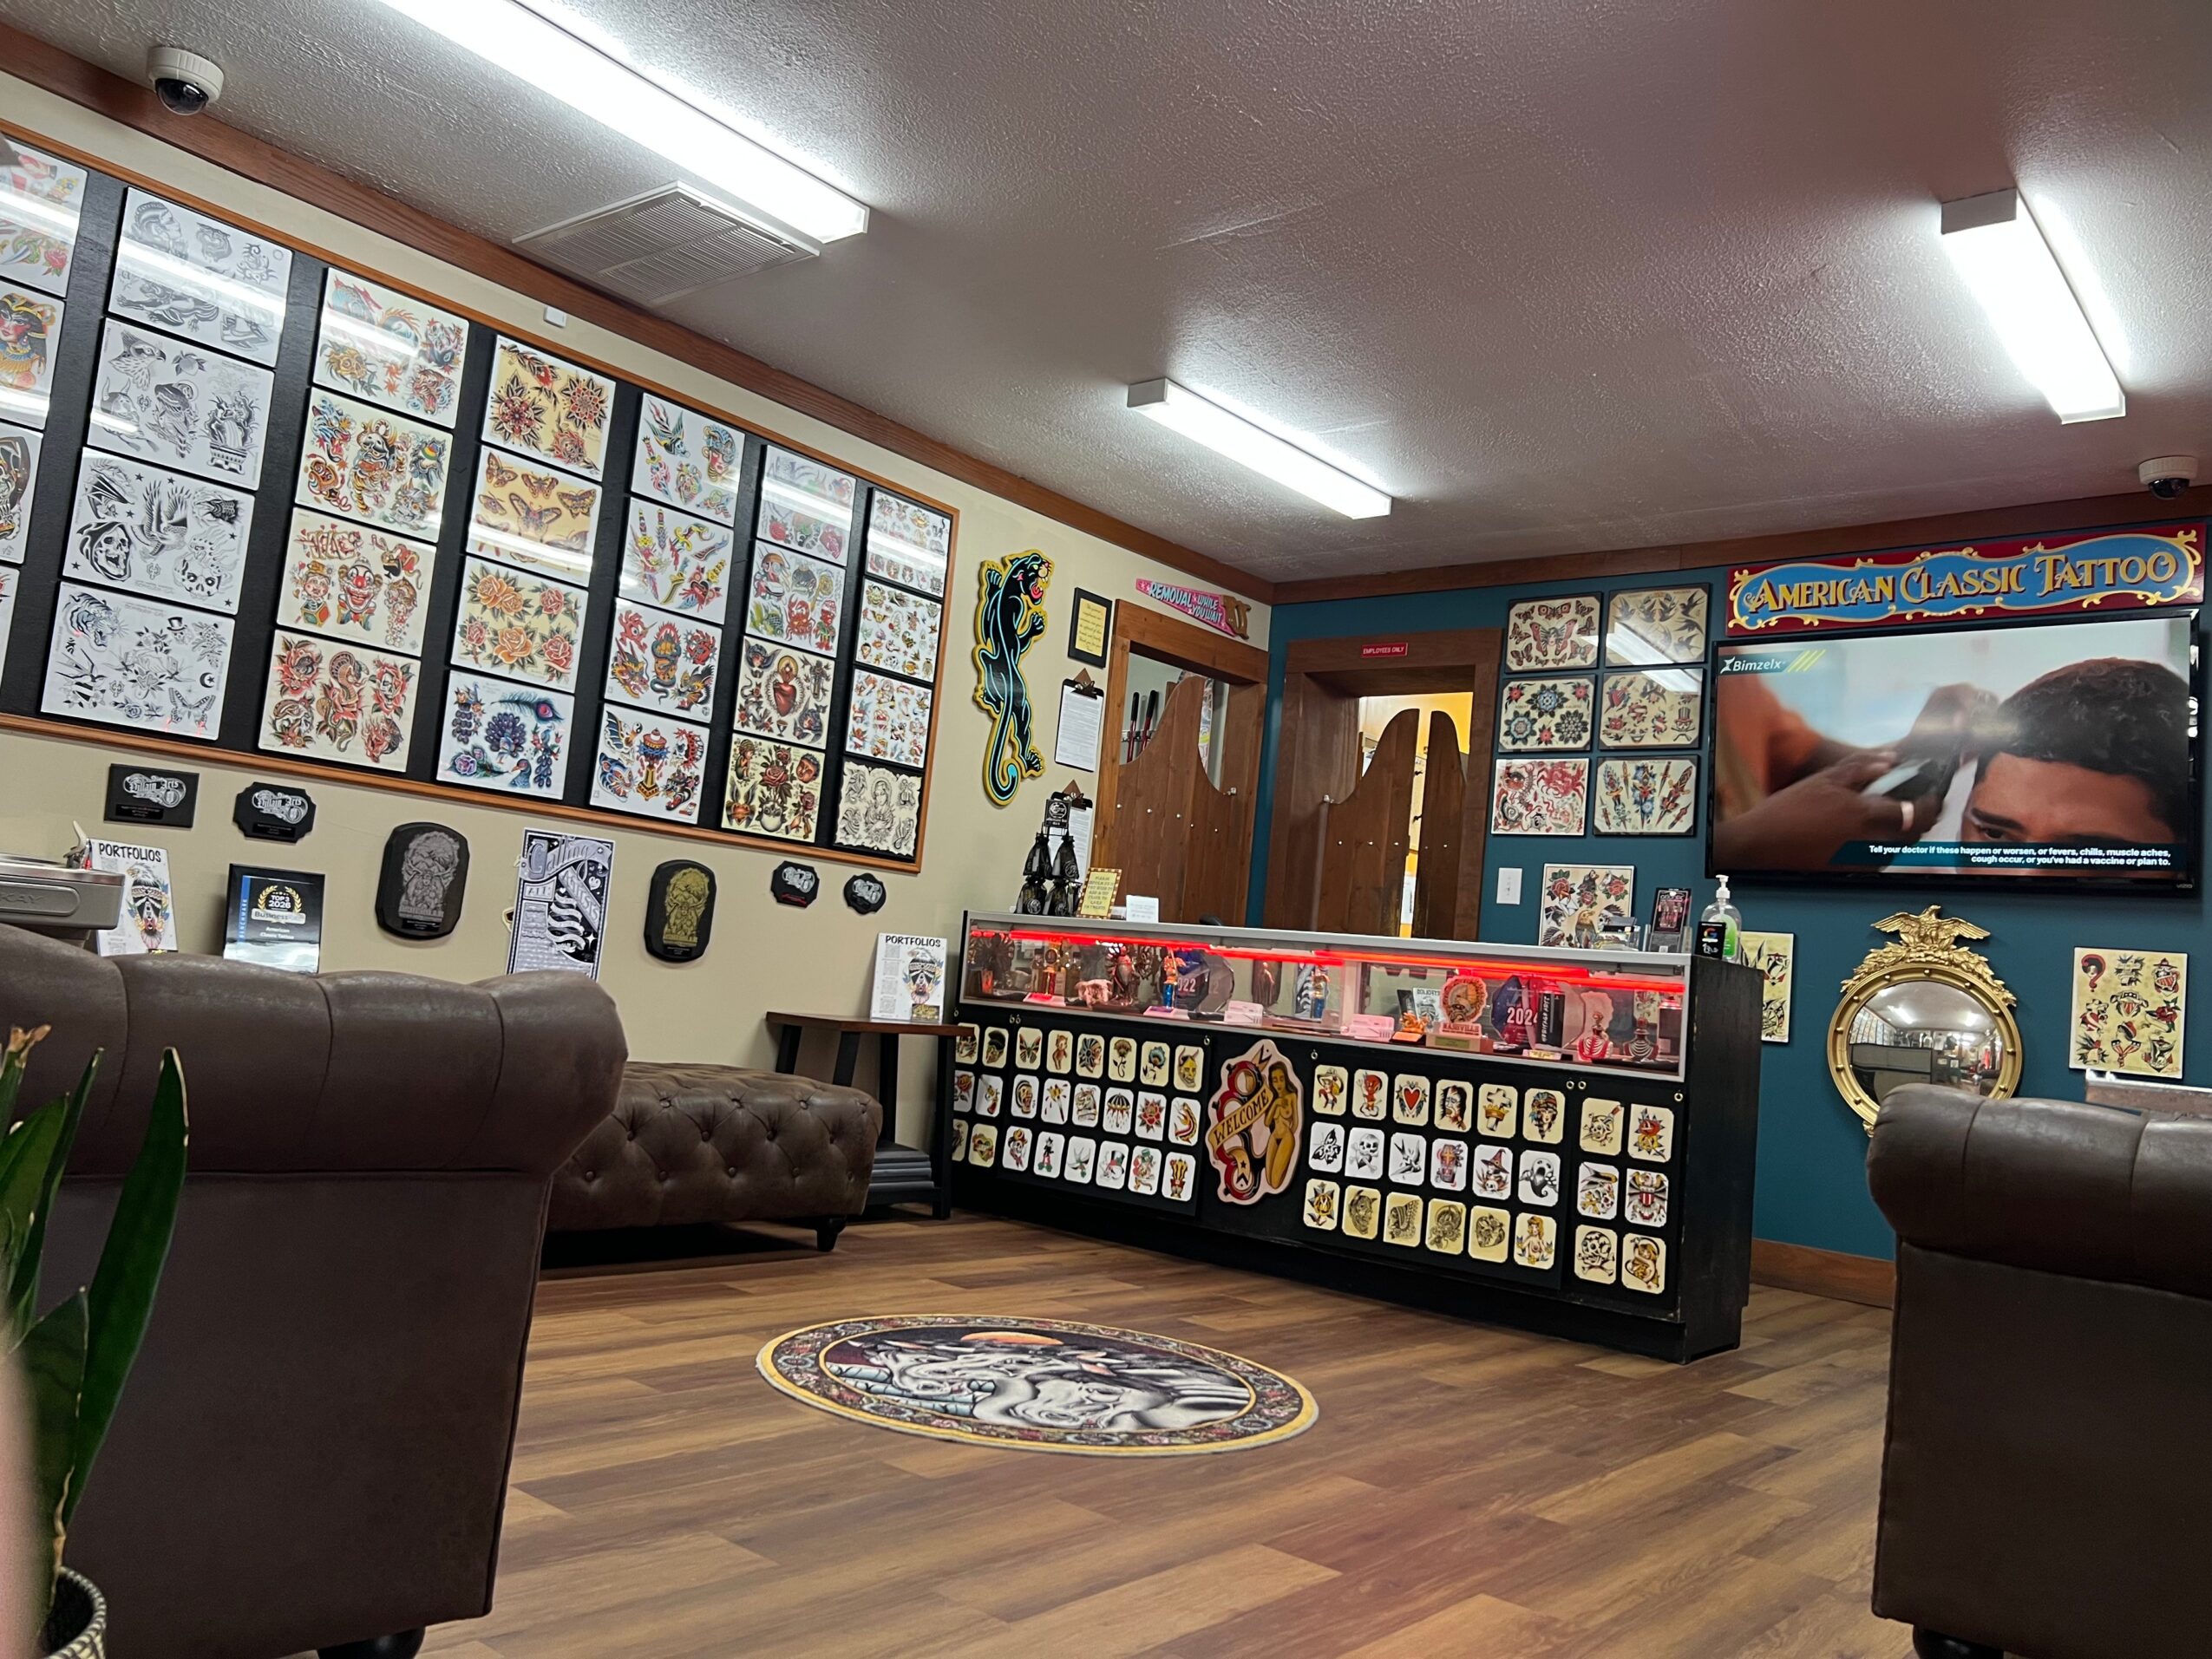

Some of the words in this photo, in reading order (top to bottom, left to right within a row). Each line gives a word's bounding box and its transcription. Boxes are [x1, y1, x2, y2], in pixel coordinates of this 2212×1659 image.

[1743, 575, 1895, 613] AMERICAN
[1900, 563, 2027, 604] CLASSIC
[2034, 551, 2176, 597] TATTOO
[1197, 595, 1219, 610] WHILE
[1192, 604, 1207, 618] YOU
[1206, 610, 1223, 624] WAIT
[1732, 658, 1781, 671] Bimzelx
[99, 843, 161, 863] PORTFOLIOS
[1868, 845, 1882, 853] Tell
[1883, 846, 1901, 855] your
[1960, 846, 1992, 857] happen
[2049, 848, 2078, 857] fevers,
[2080, 848, 2105, 857] chills,
[2106, 848, 2139, 857] muscle
[2141, 849, 2171, 859] aches,
[1971, 855, 1997, 864] cough
[2037, 857, 2065, 865] you've
[2090, 857, 2125, 865] vaccine
[2137, 857, 2156, 867] plan
[2158, 857, 2171, 865] to.
[885, 935, 941, 948] PORTFOLIOS
[1213, 1088, 1269, 1145] WELCOME
